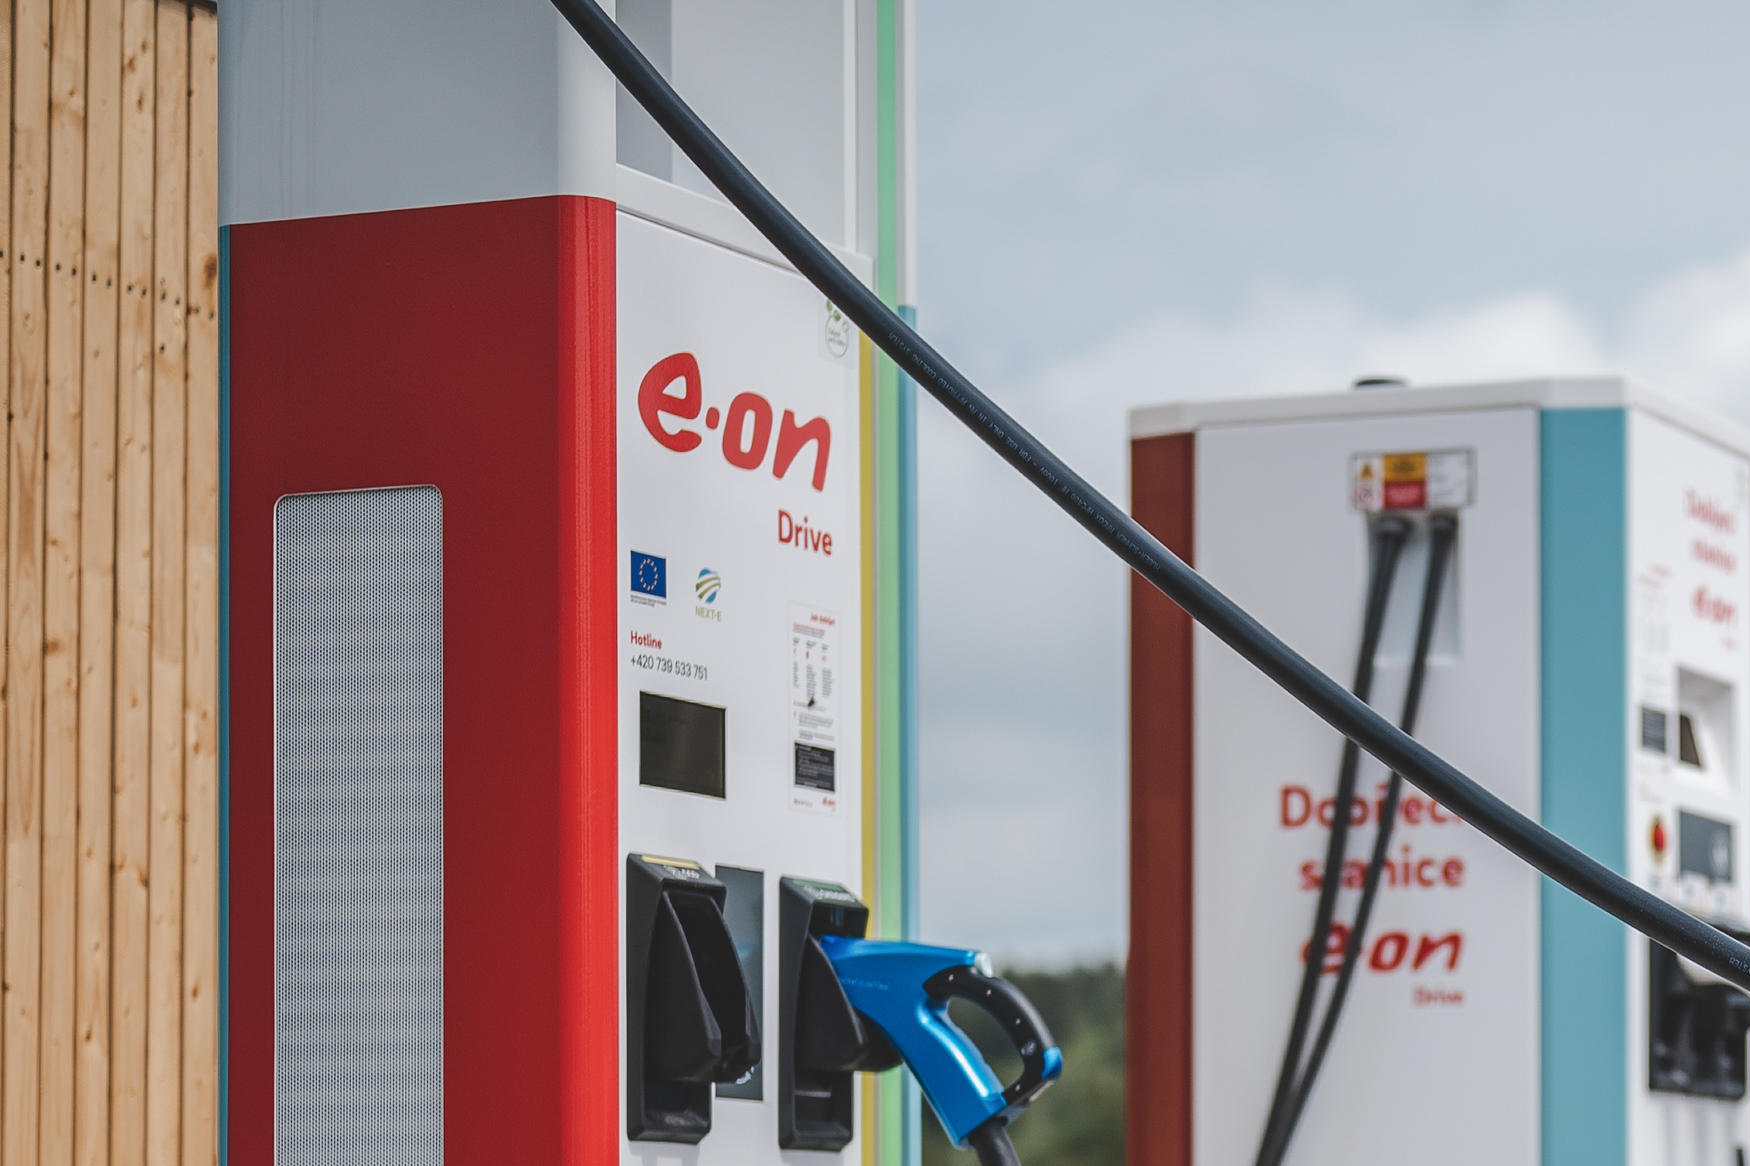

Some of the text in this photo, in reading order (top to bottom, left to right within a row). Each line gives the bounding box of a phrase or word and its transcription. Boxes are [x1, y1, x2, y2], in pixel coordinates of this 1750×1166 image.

[887, 331, 911, 355] SYSTEM
[911, 353, 937, 378] COOLING
[936, 376, 968, 406] APPROVED
[986, 421, 1005, 439] ONLY
[1004, 436, 1019, 450] USE
[1017, 448, 1033, 462] FOR
[778, 509, 832, 555] Drive
[630, 630, 662, 650] Hotline
[630, 654, 708, 681] +420 739 533 751
[1300, 844, 1464, 889] sanice
